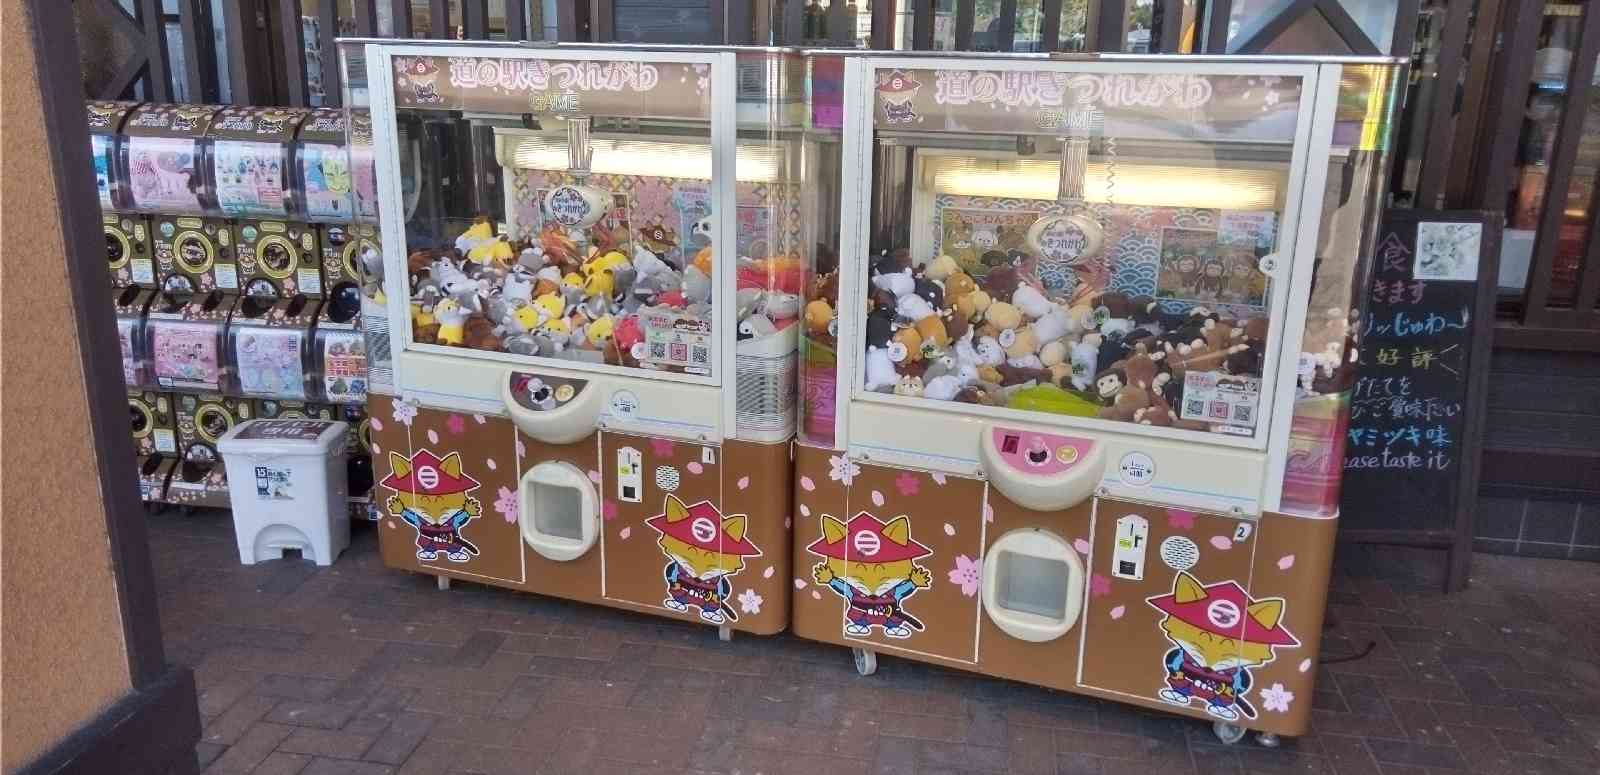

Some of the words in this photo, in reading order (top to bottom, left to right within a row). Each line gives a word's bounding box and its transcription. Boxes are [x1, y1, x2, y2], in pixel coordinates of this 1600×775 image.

[449, 57, 658, 90] 道の駅きつれがわ
[935, 71, 1212, 107] 道の駅きつれがわ
[533, 95, 578, 112] GAME
[1038, 111, 1100, 129] GAME
[1376, 231, 1411, 272] 食
[1373, 280, 1426, 304] きます
[1381, 447, 1424, 469] taste
[1427, 450, 1450, 470] it
[1237, 526, 1245, 539] 2
